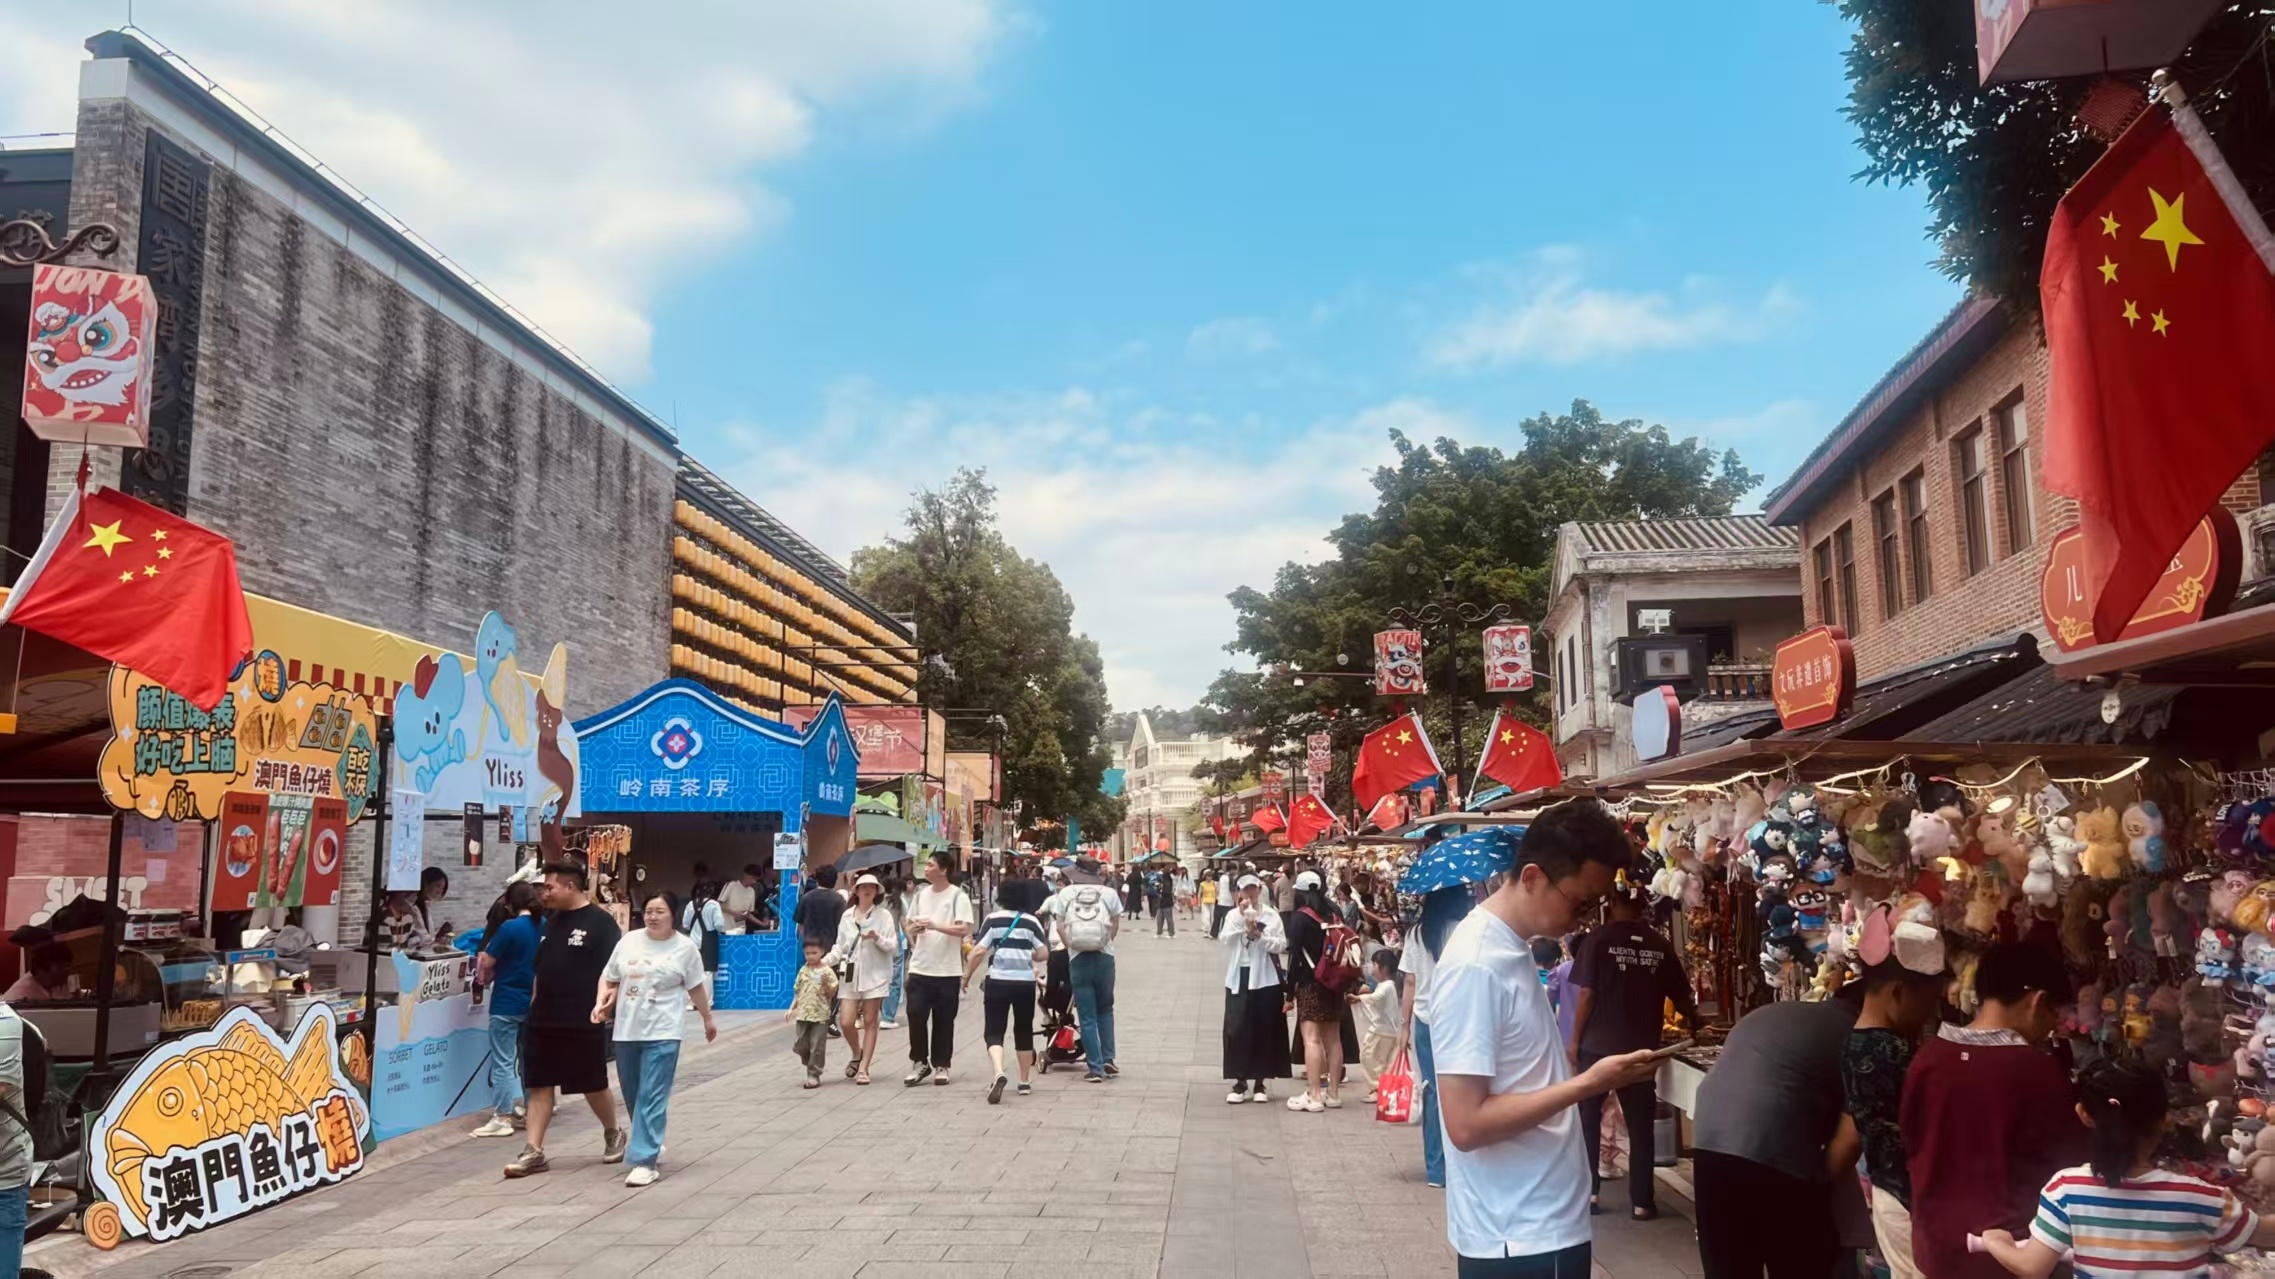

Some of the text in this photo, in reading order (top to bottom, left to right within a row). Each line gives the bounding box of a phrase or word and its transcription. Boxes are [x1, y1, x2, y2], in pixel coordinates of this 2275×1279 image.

[135, 732, 236, 776] 好吃上脑
[485, 758, 524, 788] Yliss
[619, 777, 729, 798] 岭南茶序
[427, 960, 450, 981] Yliss
[423, 979, 450, 996] Gelato
[424, 1040, 448, 1056] GELATO
[149, 1095, 361, 1231] 澳門魚仔燒
